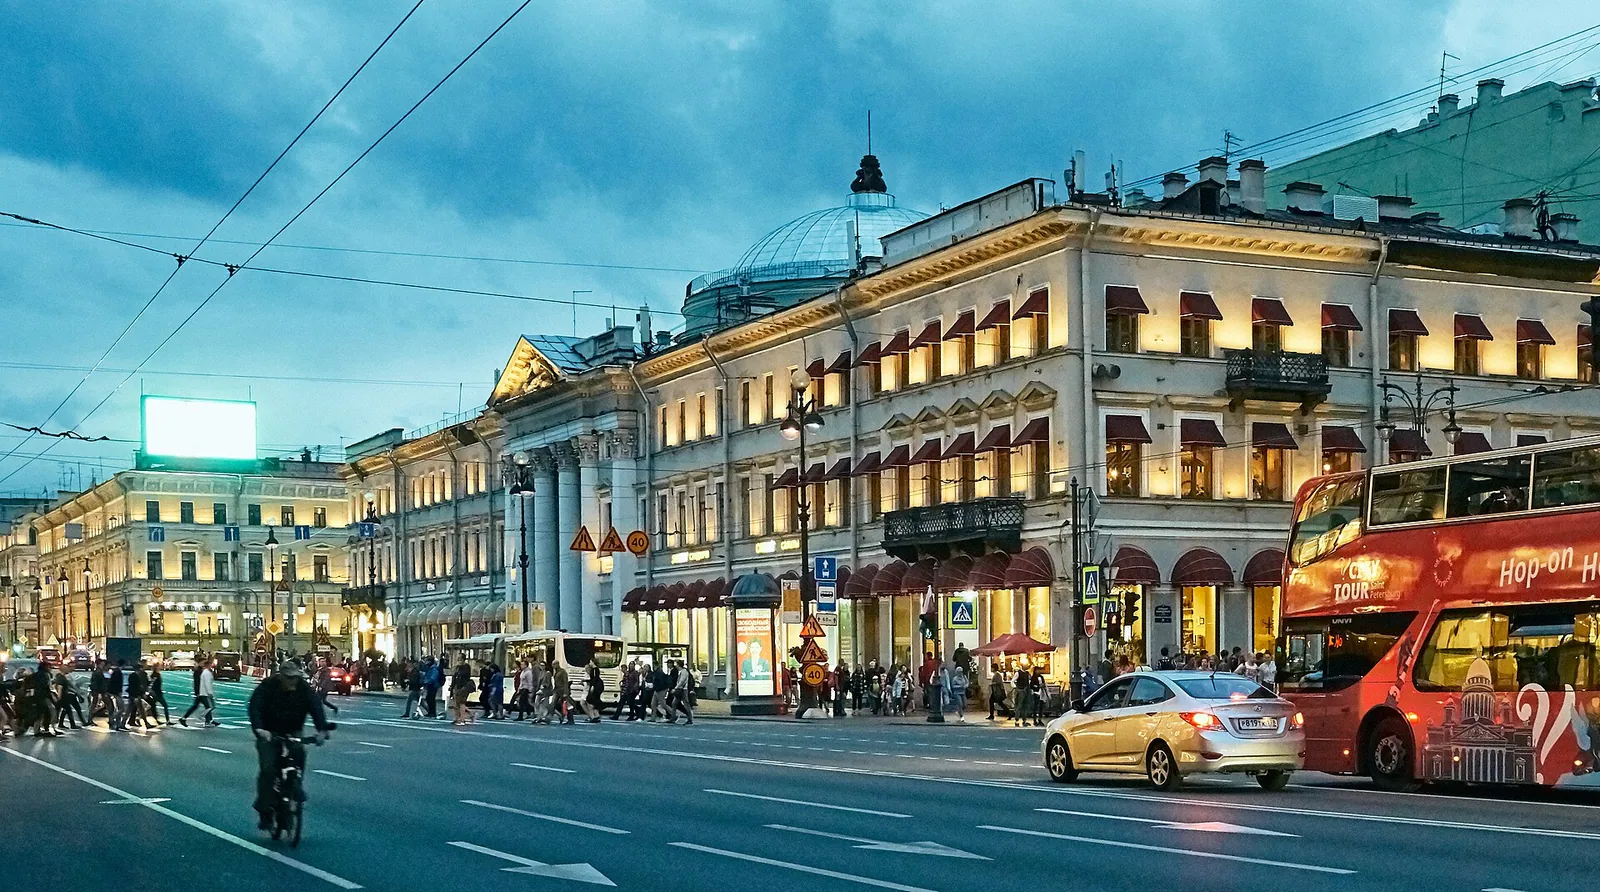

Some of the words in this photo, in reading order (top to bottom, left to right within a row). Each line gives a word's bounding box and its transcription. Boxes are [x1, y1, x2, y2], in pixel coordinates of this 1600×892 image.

[631, 537, 645, 547] 40
[1500, 547, 1574, 588] Hop-on
[1582, 552, 1600, 583] H
[1334, 582, 1369, 603] TOUR
[807, 670, 821, 680] 40
